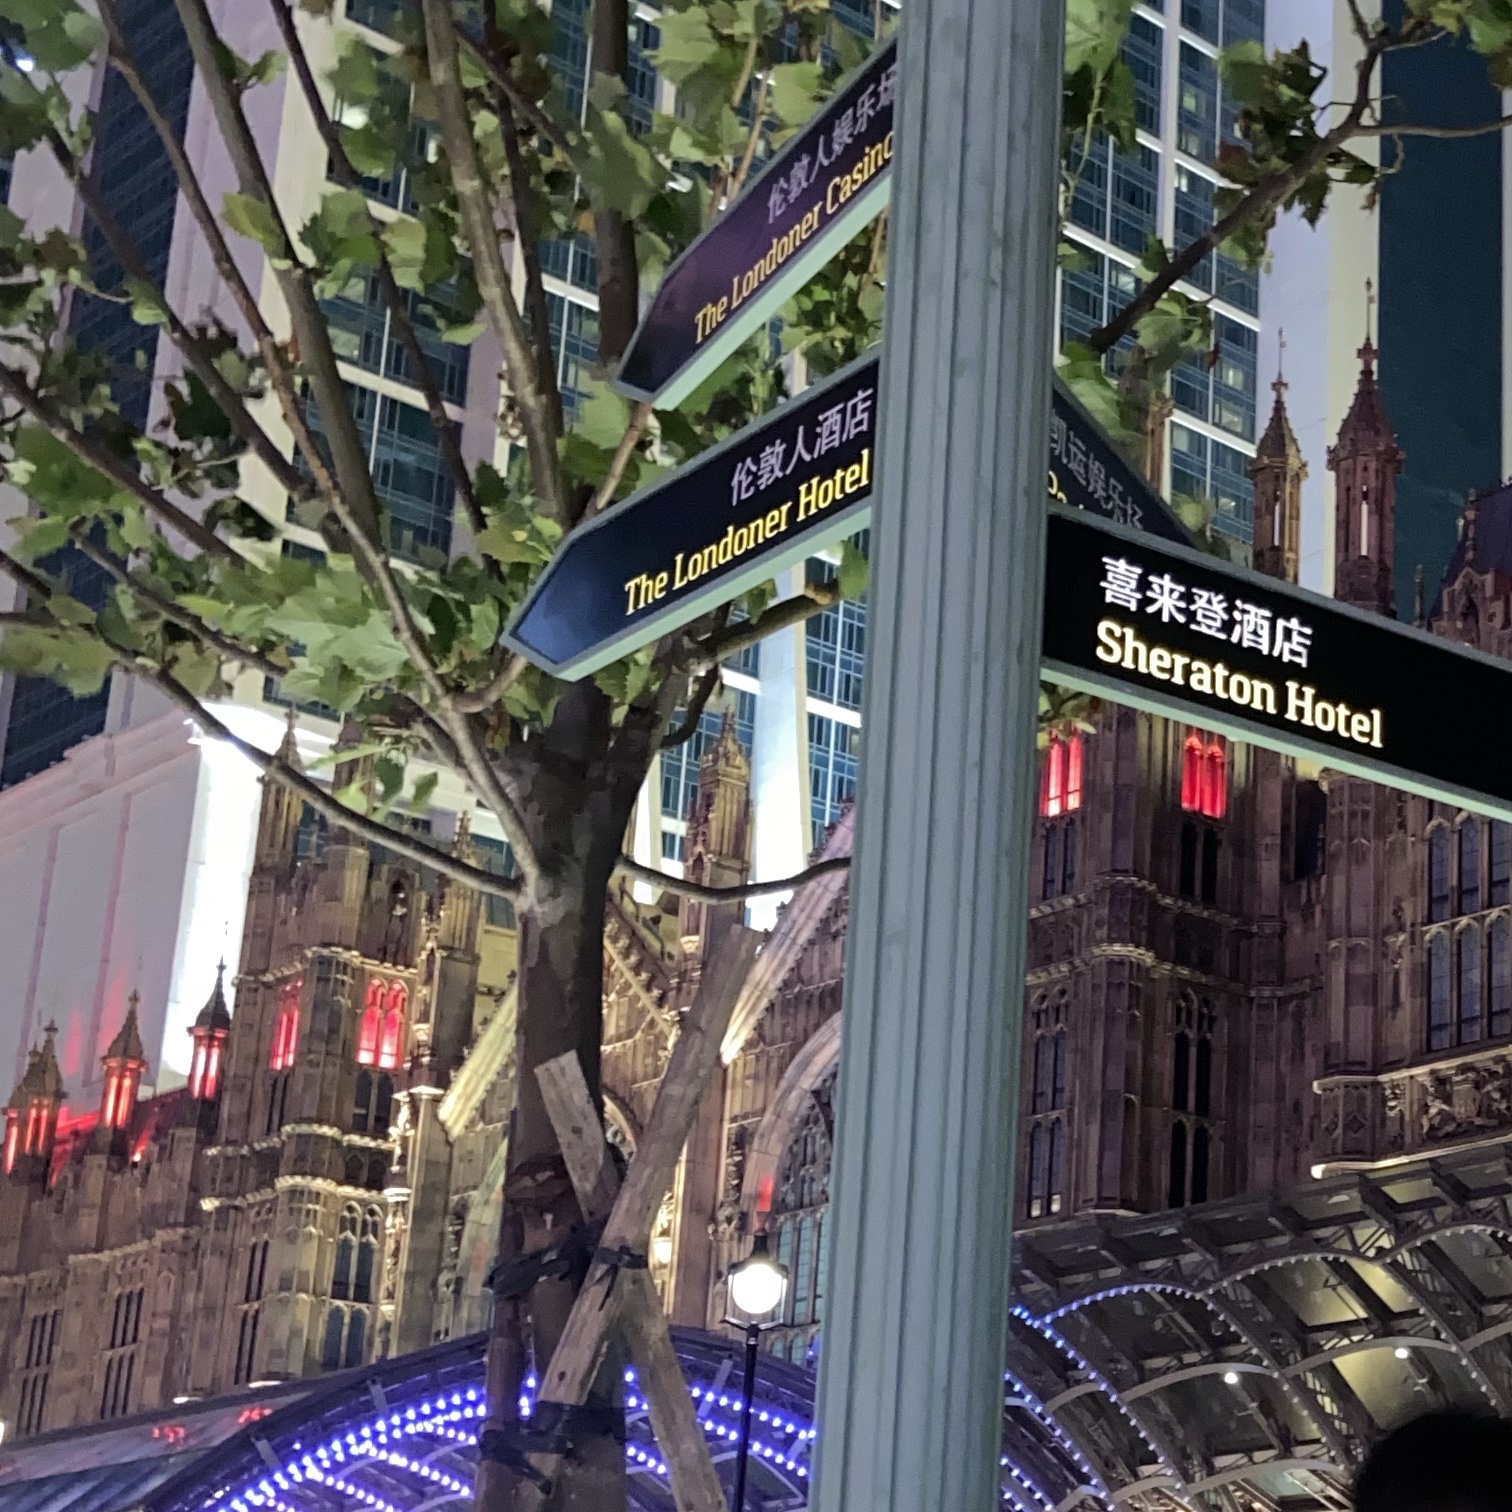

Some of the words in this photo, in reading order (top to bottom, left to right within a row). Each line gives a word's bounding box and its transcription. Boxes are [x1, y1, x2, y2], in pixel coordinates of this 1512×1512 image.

[694, 295, 728, 345] The
[731, 200, 823, 310] Londoner
[825, 130, 894, 216] Casino
[731, 388, 874, 507] 伦敦人酒店
[624, 570, 669, 616] The
[672, 501, 793, 591] Londoner
[796, 447, 871, 522] Hotel
[1099, 555, 1314, 668] 喜来登酒店
[1096, 620, 1279, 715] Sheraton
[1284, 680, 1385, 749] Hotel
